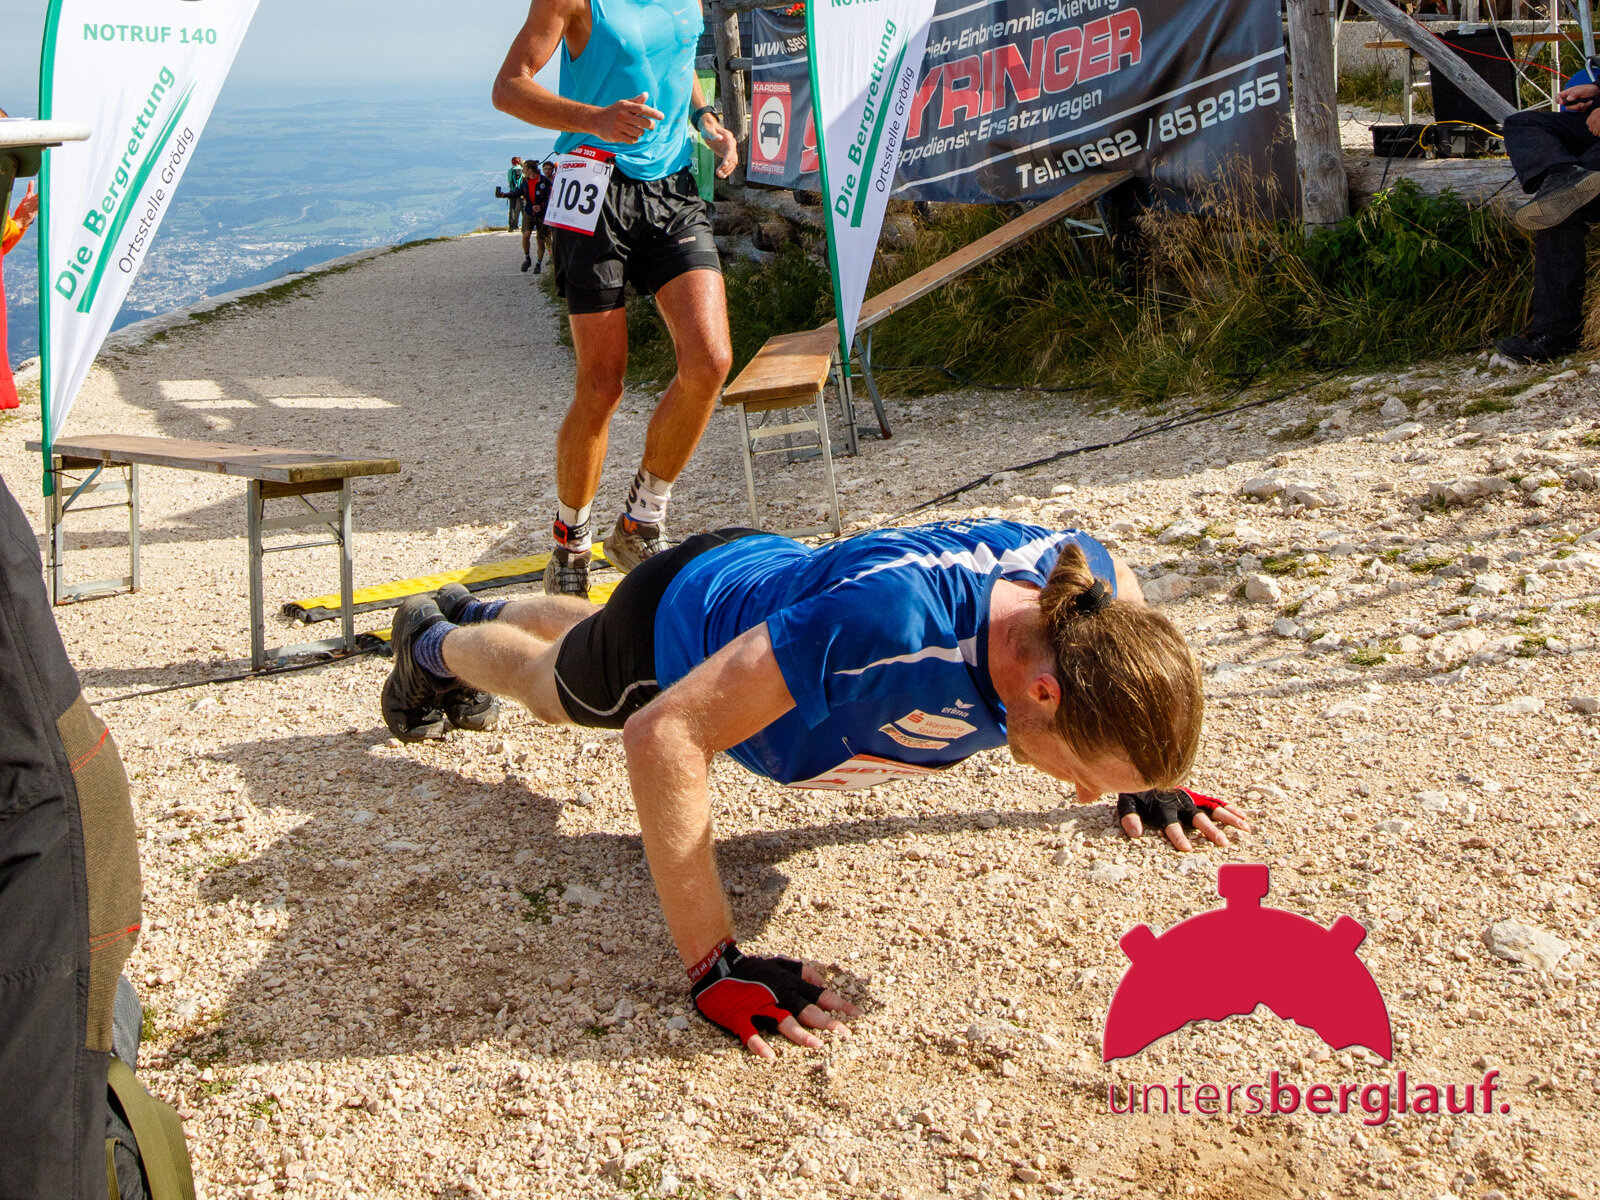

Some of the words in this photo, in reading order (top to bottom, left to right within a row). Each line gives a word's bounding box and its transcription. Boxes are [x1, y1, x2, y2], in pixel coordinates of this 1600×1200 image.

[83, 23, 172, 44] NOTRUF
[179, 25, 218, 45] 140
[835, 174, 857, 218] Die
[847, 18, 897, 166] Bergrettung
[876, 120, 900, 193] Ortsstelle
[894, 66, 915, 117] Grödig
[54, 246, 94, 301] Die
[82, 65, 176, 238] Bergrettung
[118, 187, 166, 275] Ortsstelle
[160, 126, 195, 185] Grödig
[556, 177, 599, 215] 103
[941, 707, 970, 718] erima
